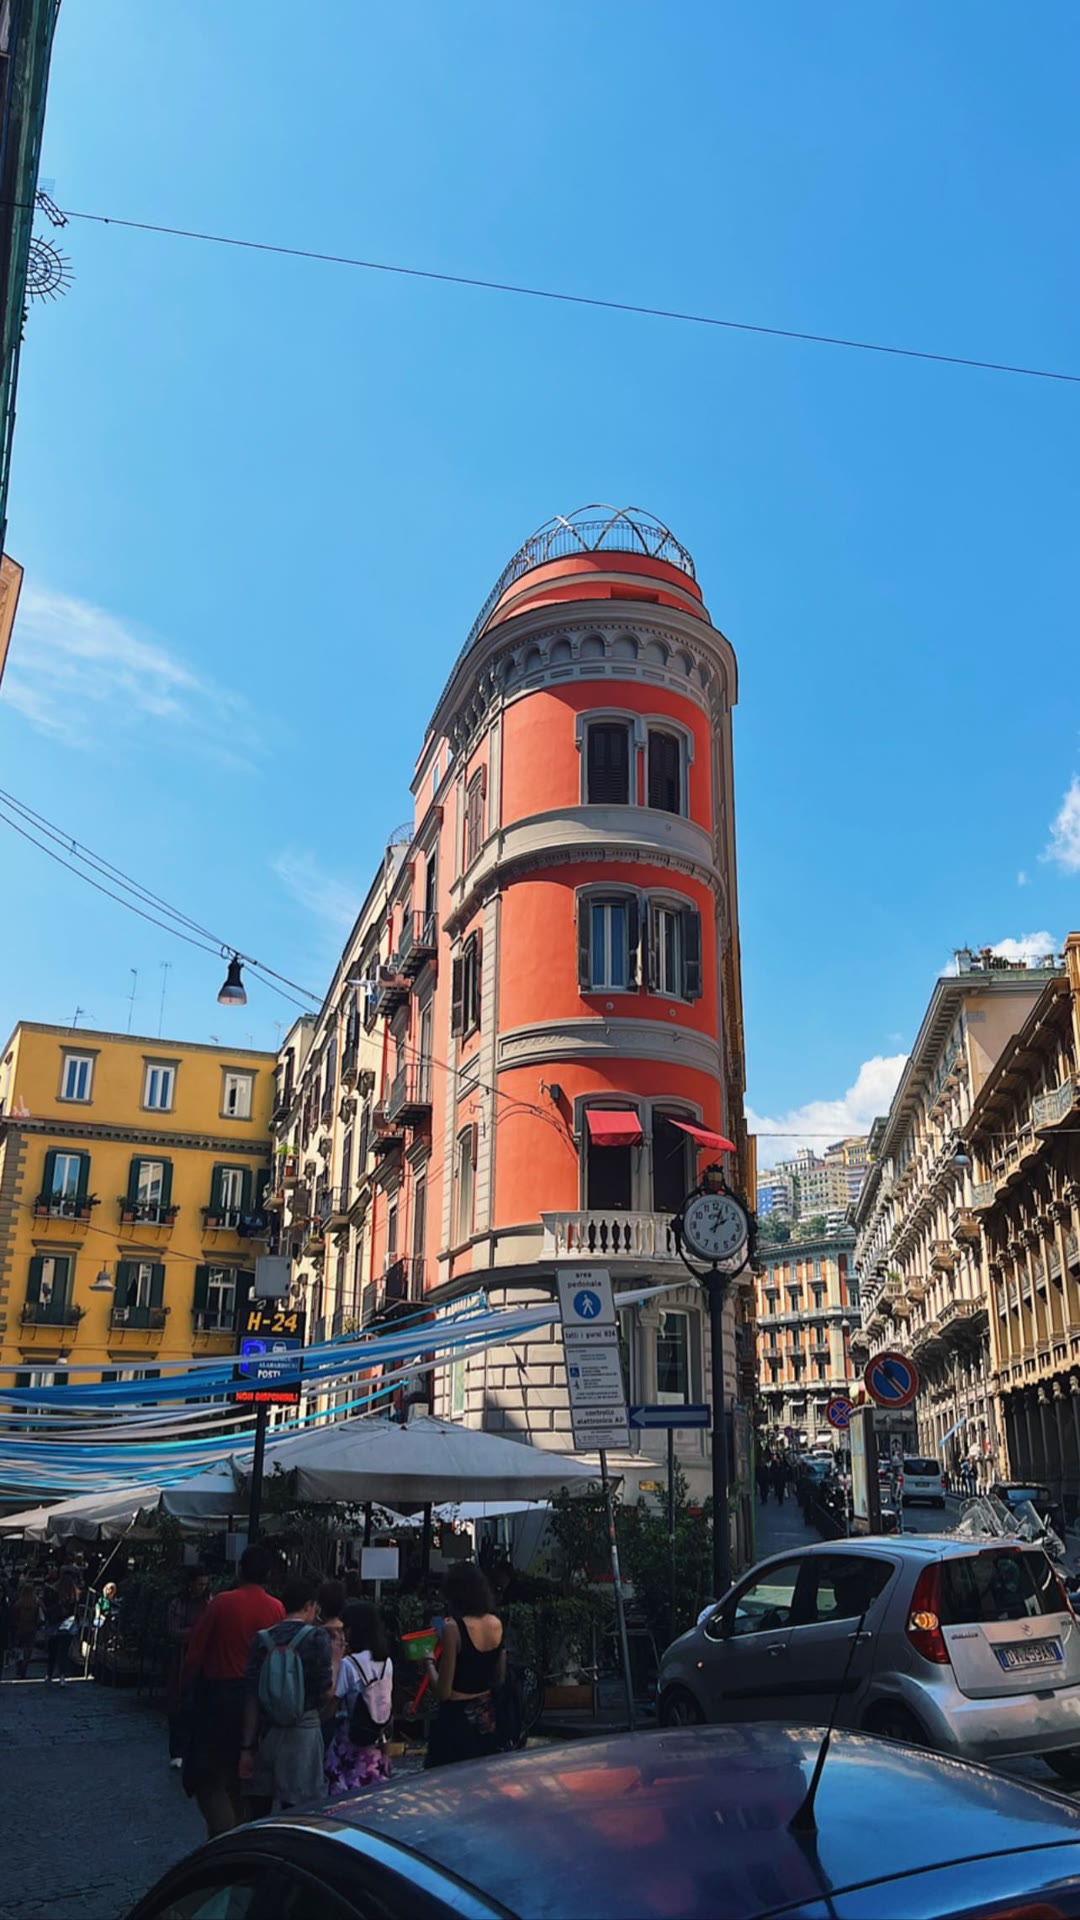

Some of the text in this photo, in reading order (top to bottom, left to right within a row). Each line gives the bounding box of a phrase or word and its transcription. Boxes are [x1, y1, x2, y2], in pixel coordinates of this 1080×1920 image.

[704, 1204, 710, 1213] 11
[712, 1202, 720, 1211] 12
[725, 1205, 729, 1214] 1
[695, 1211, 703, 1220] 10
[731, 1212, 737, 1221] 2
[735, 1223, 741, 1232] 3
[731, 1233, 736, 1242] 4
[704, 1238, 709, 1247] 7
[713, 1241, 719, 1251] 6
[723, 1240, 729, 1249] 5
[575, 1271, 592, 1279] area
[567, 1279, 602, 1289] pedonale
[247, 1311, 298, 1333] H-24
